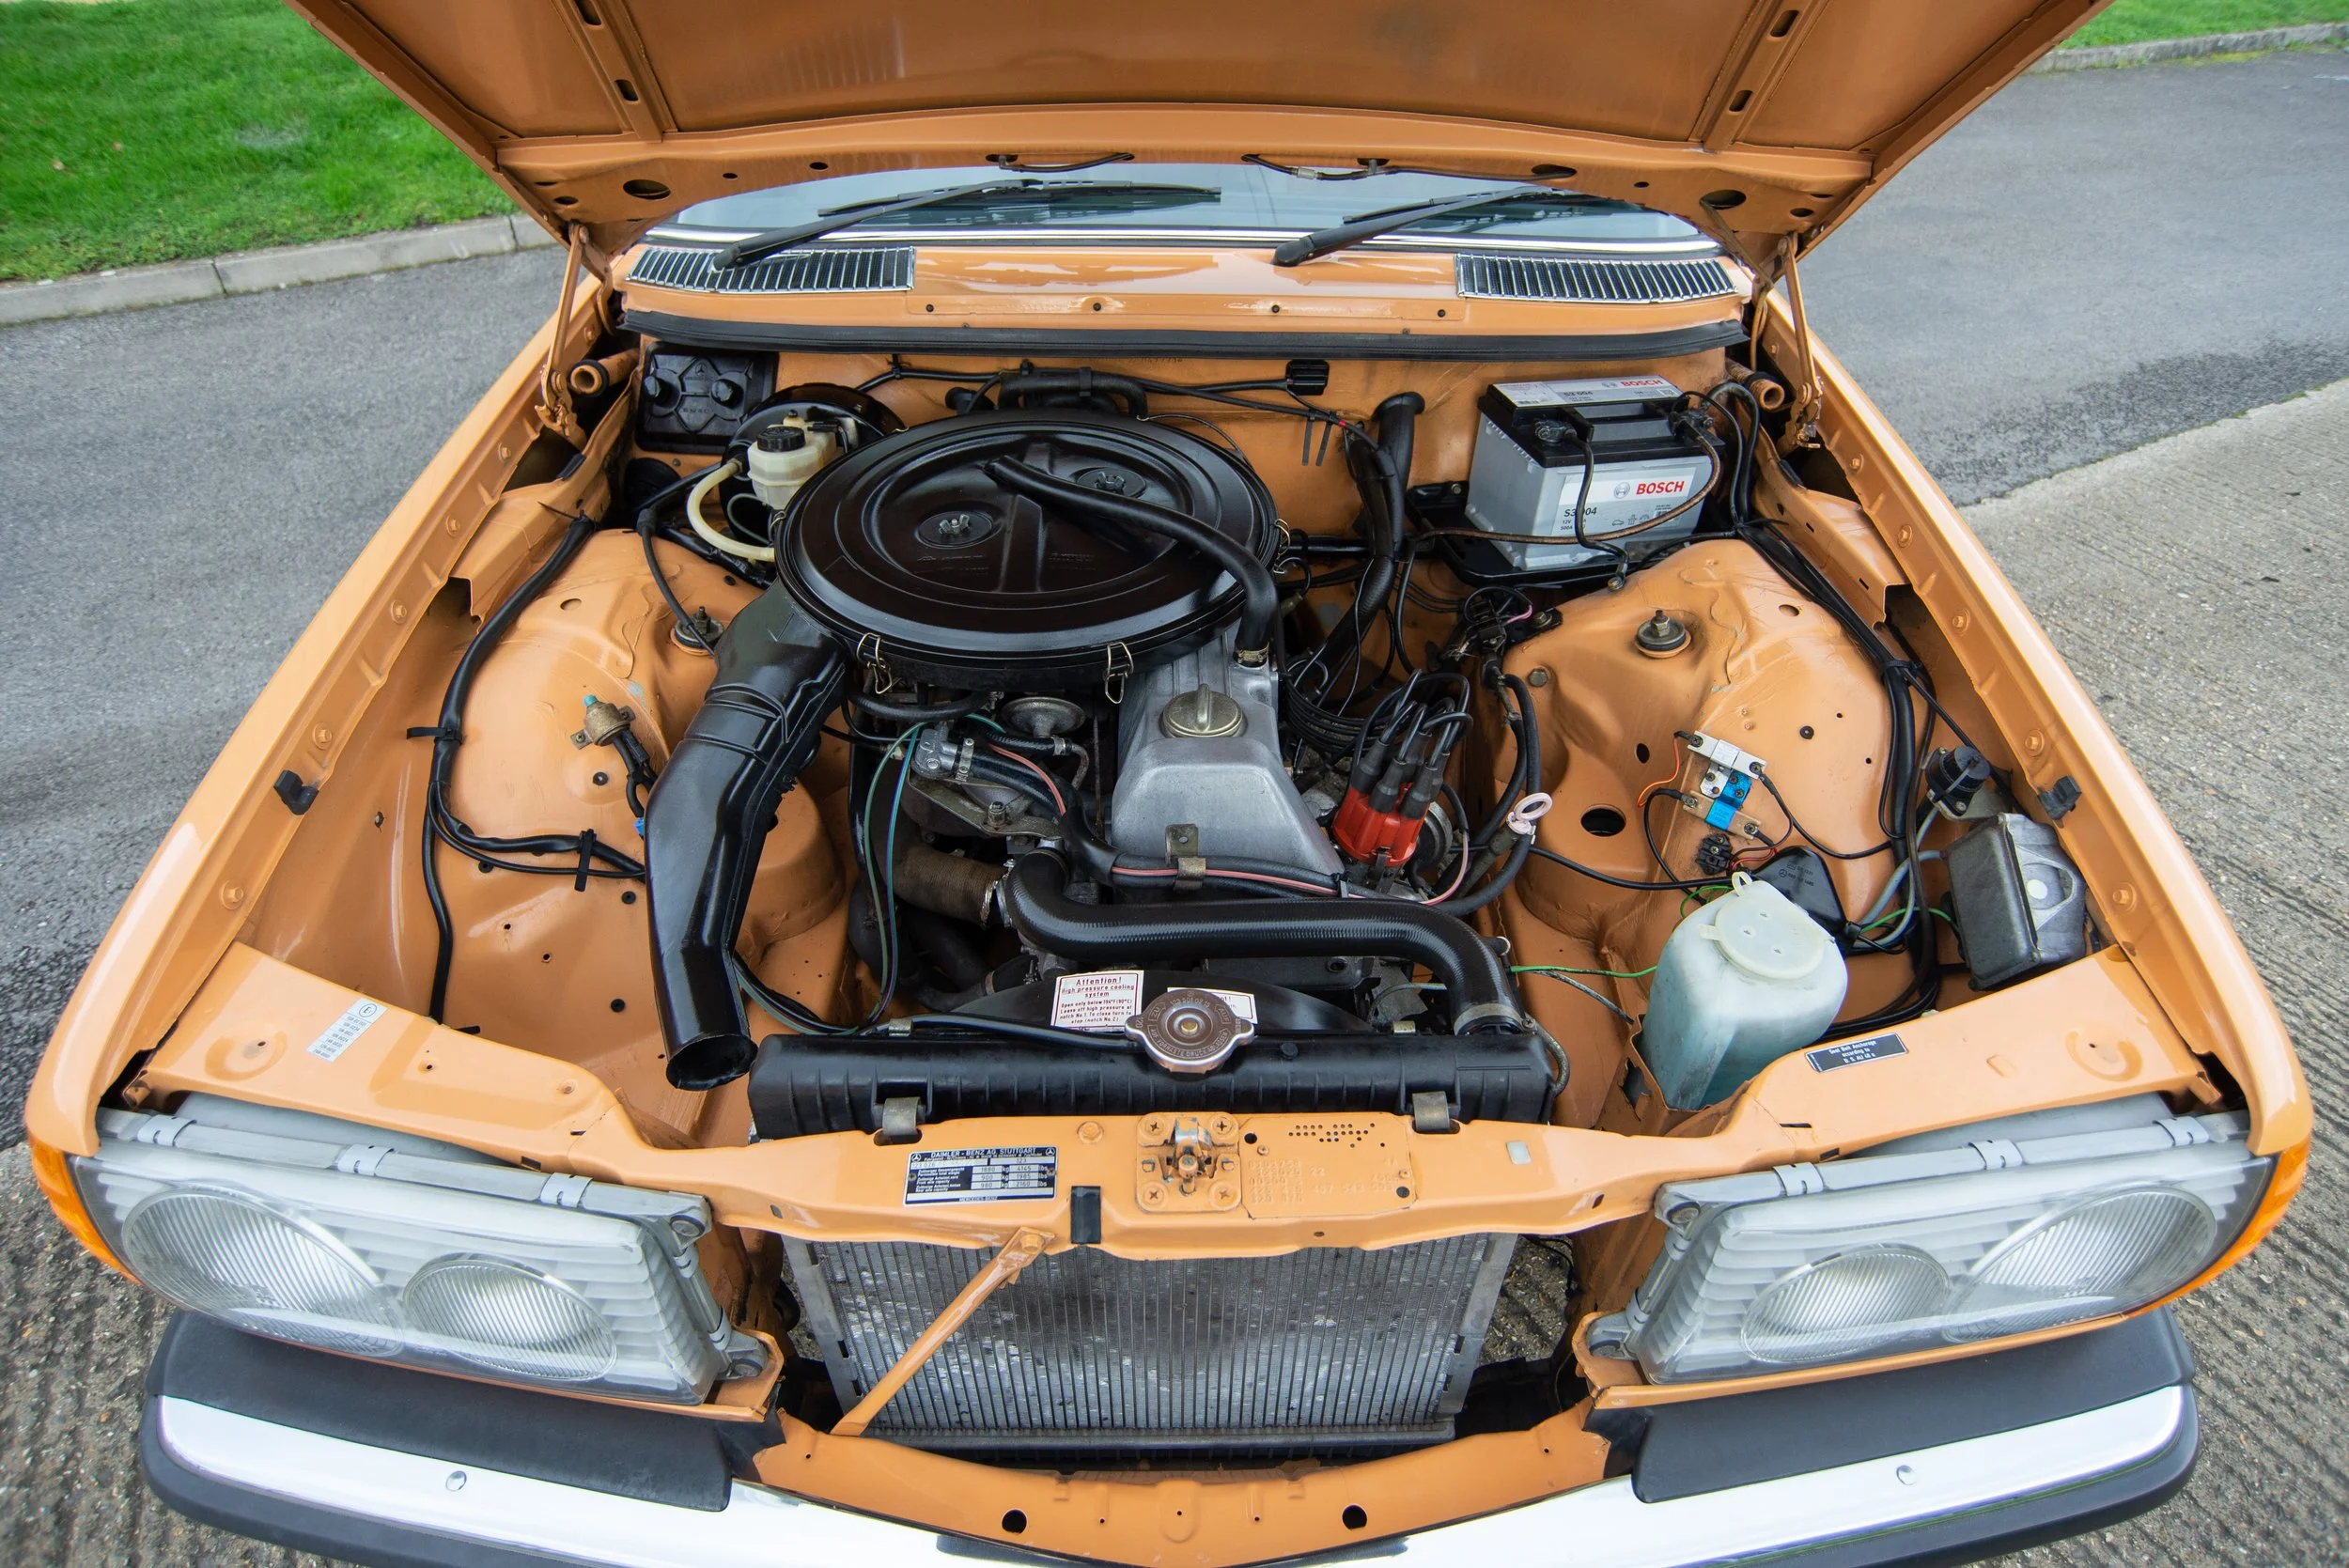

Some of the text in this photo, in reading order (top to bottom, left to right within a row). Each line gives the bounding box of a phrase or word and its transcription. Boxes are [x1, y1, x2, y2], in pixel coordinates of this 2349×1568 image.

[1636, 481, 1685, 495] BOSCH
[1564, 508, 1577, 517] S3
[1076, 977, 1121, 986] Attention!
[1151, 1006, 1160, 1019] ZU
[1219, 1007, 1230, 1021] AUF
[1852, 1040, 1876, 1048] Anchorage
[1842, 1048, 1864, 1057] according
